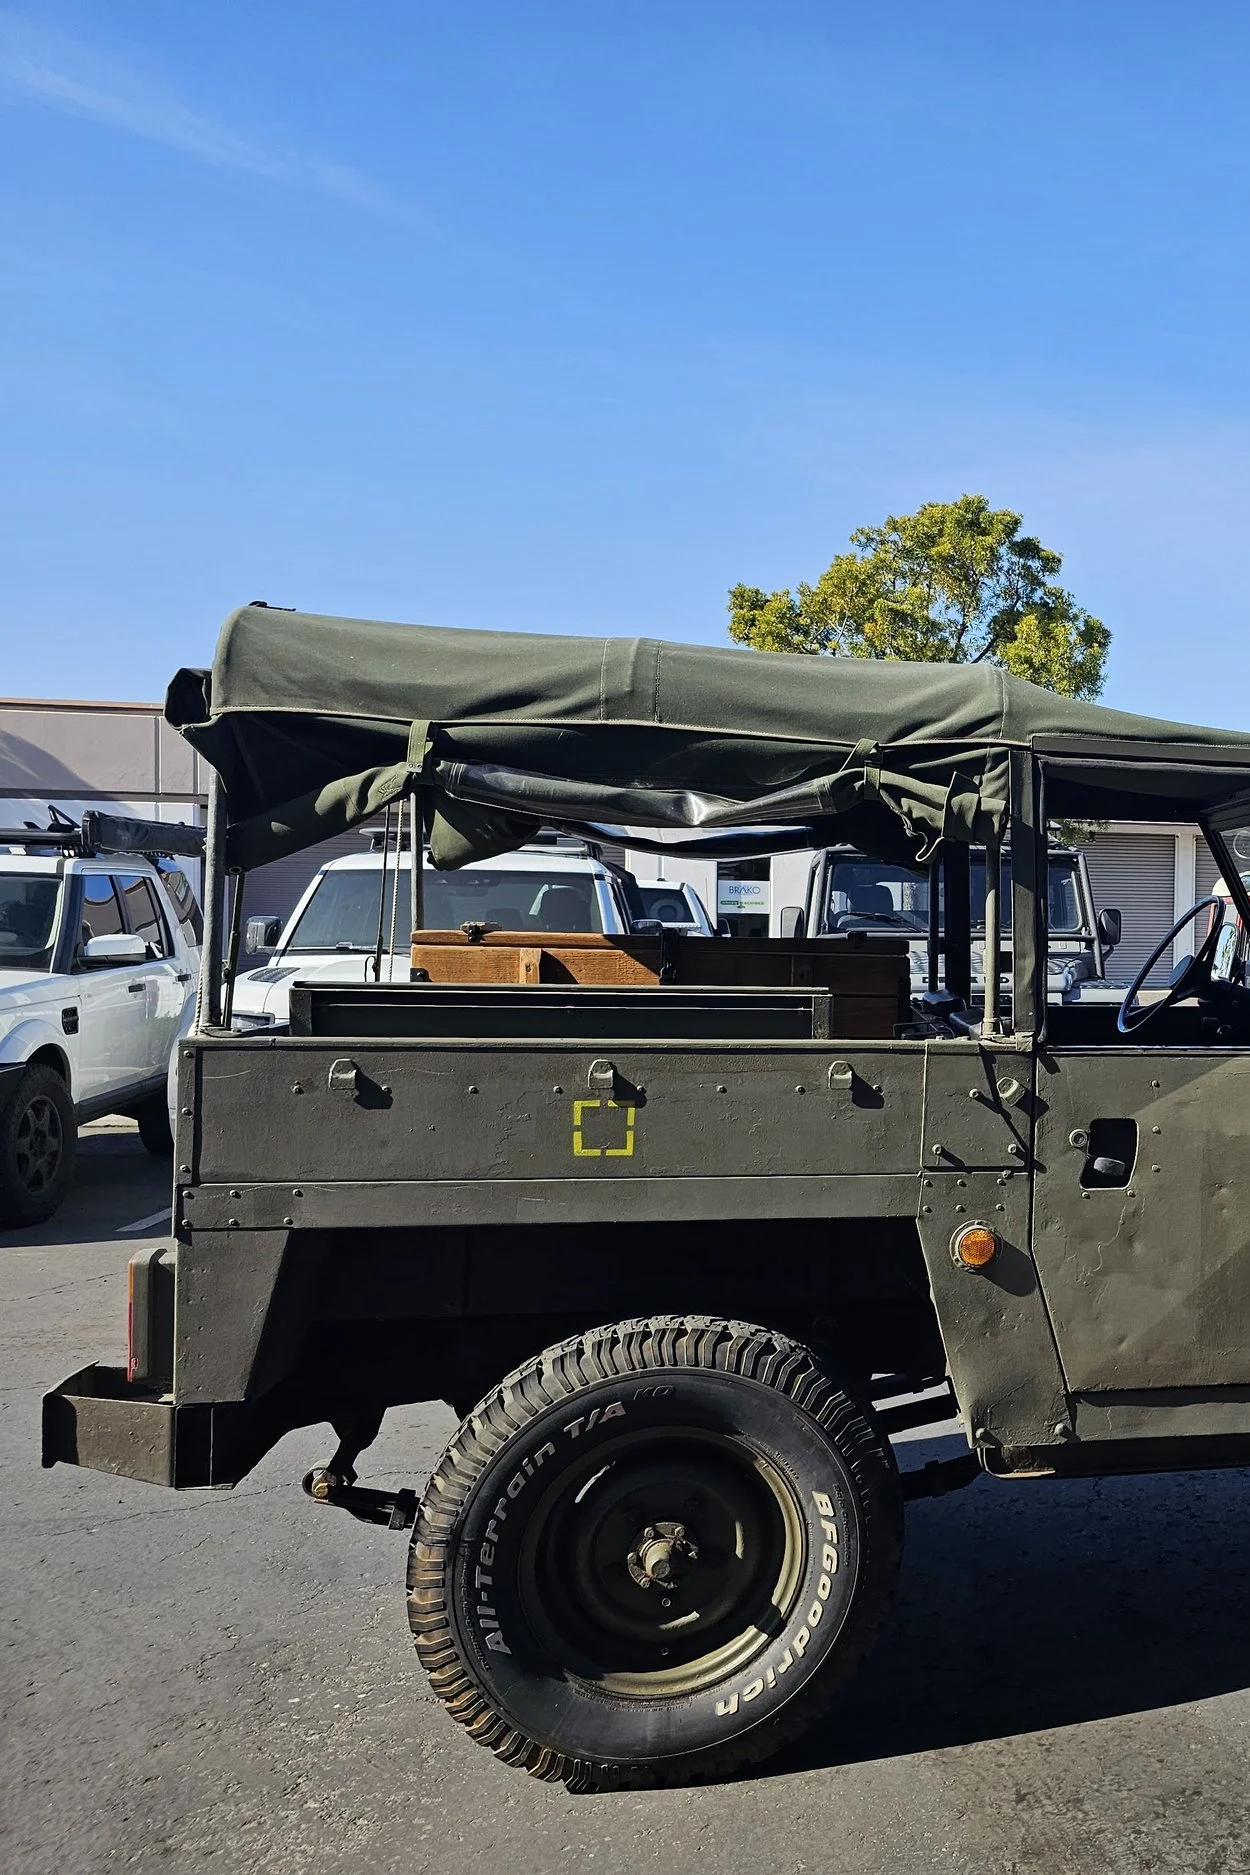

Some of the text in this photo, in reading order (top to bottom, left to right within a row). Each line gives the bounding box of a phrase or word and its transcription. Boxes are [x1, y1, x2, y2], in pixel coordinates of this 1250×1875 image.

[728, 885, 761, 894] BRAKO
[475, 1441, 556, 1655] All-Terrain
[563, 1401, 627, 1440] T/A
[715, 1490, 840, 1717] BFGoodrich
